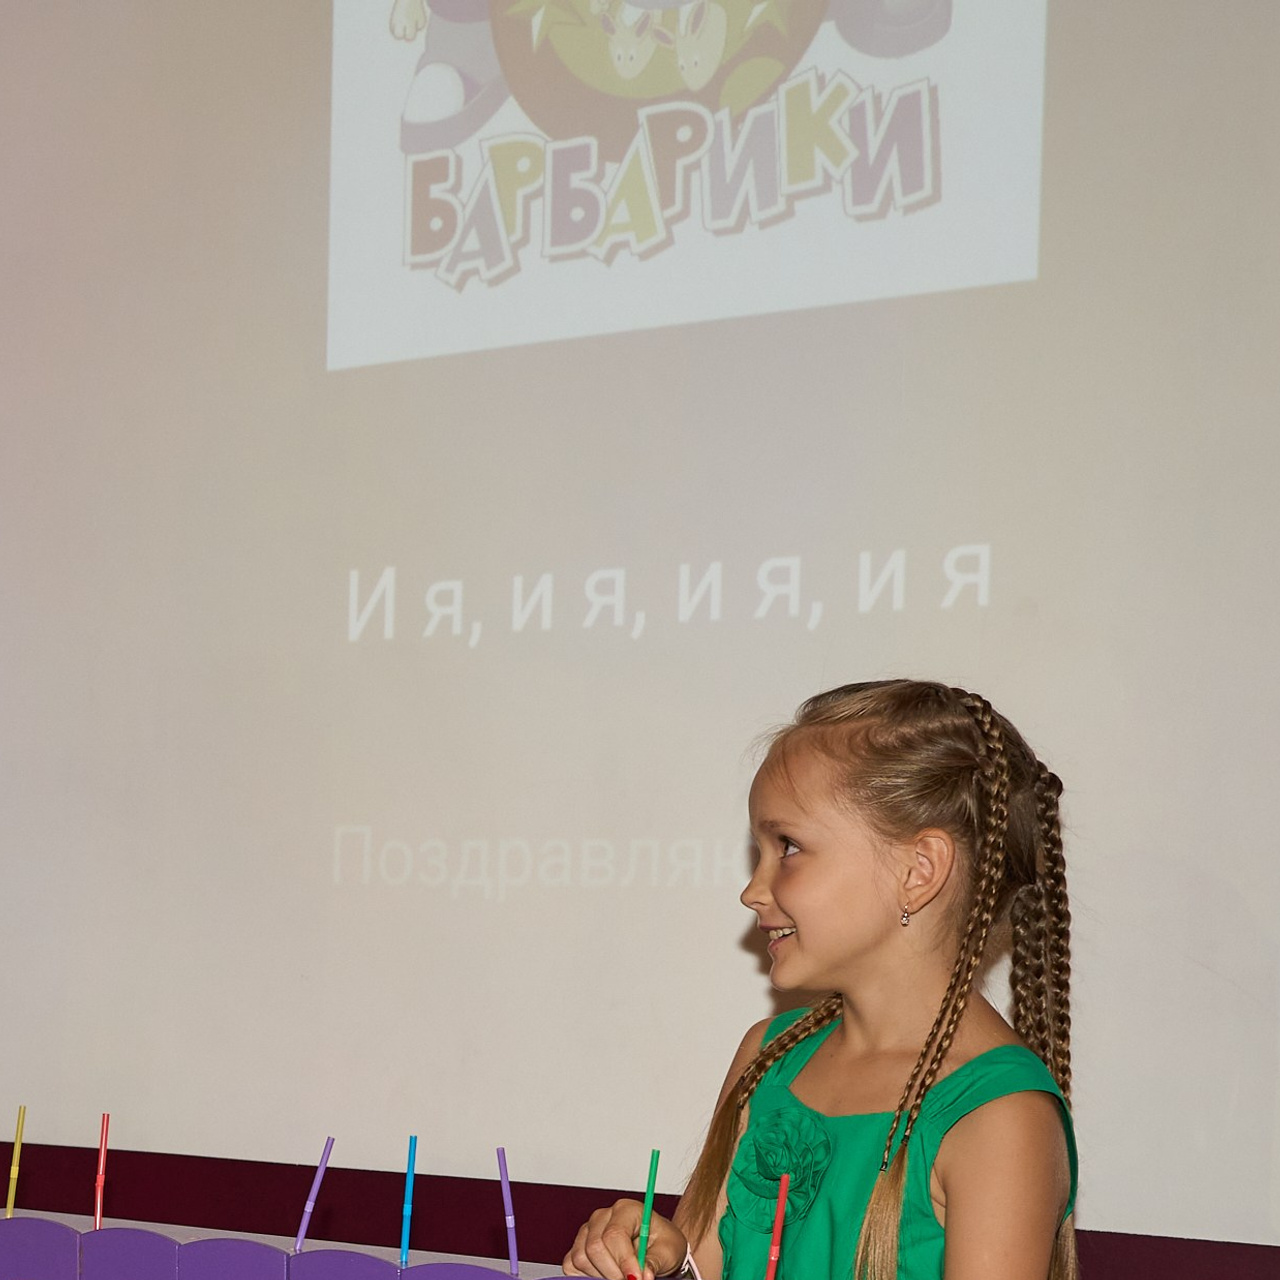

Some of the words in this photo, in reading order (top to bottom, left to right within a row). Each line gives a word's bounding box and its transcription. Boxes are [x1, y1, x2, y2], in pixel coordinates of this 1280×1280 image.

[403, 67, 942, 292] БАРБАРИКИ
[346, 565, 397, 643] И
[422, 579, 483, 649] я,
[511, 572, 554, 633] и
[677, 560, 723, 624] и
